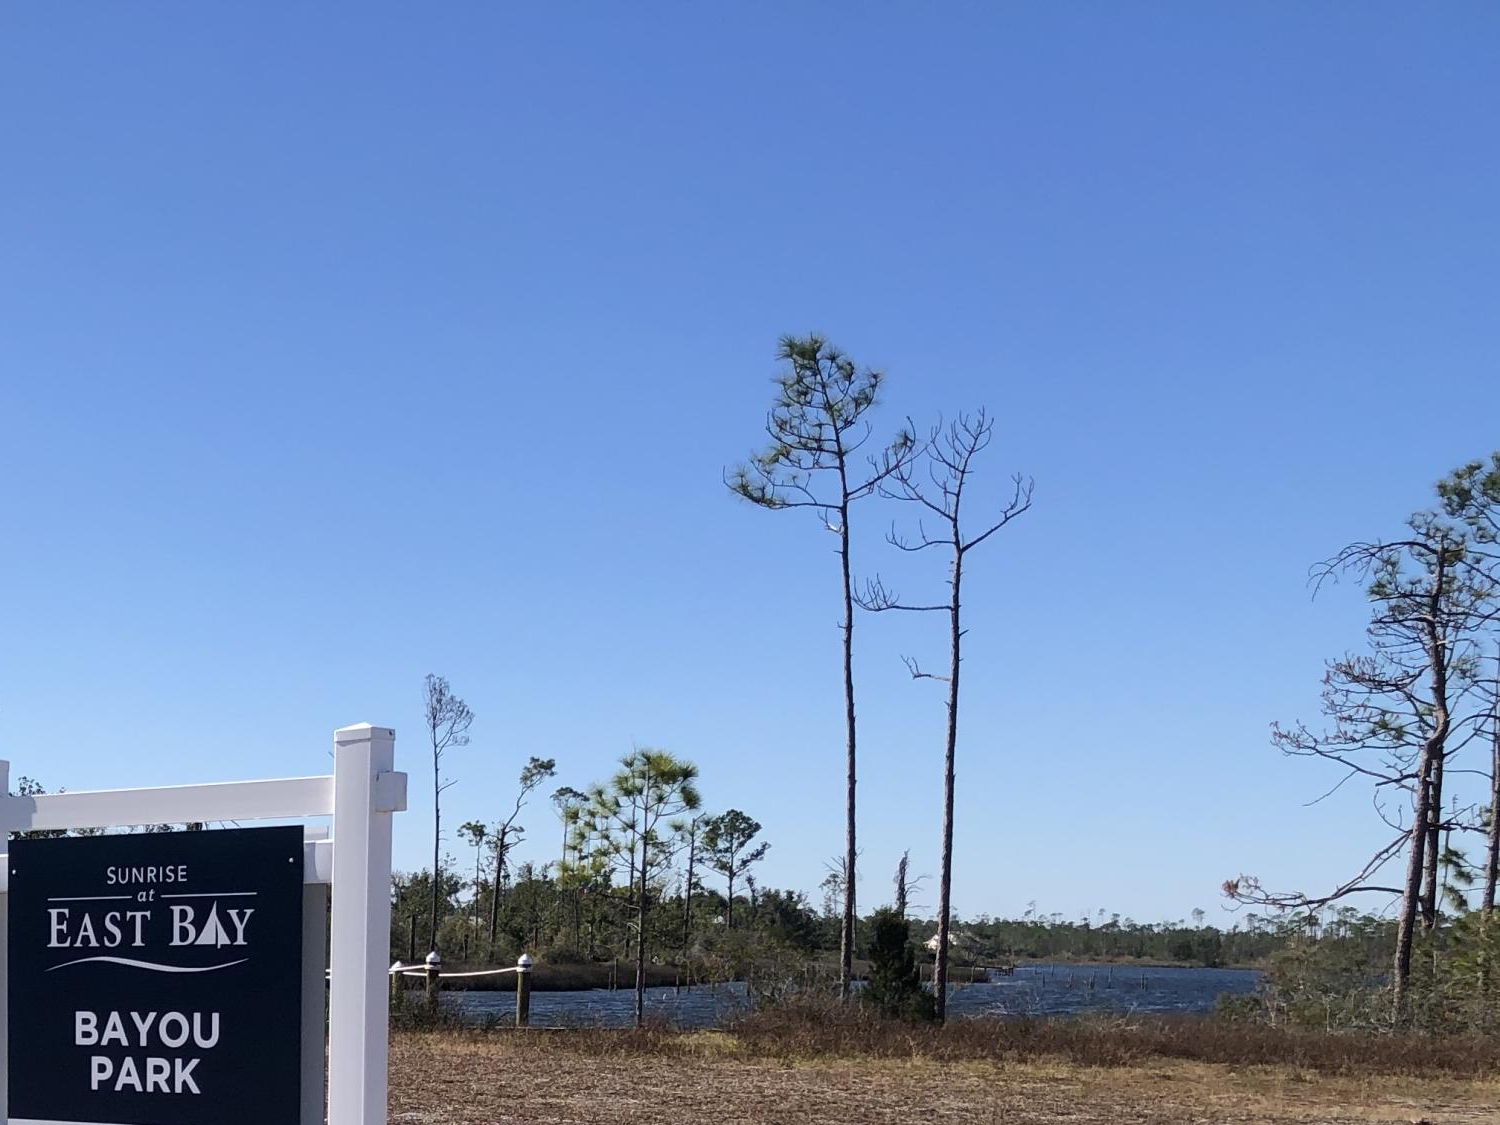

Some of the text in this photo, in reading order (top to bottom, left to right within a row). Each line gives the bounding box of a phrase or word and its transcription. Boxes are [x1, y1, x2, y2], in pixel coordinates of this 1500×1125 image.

[106, 865, 188, 885] SUNRISE
[137, 888, 155, 902] at
[46, 901, 255, 949] EAST BAY
[74, 1010, 221, 1049] BAYOU
[90, 1055, 201, 1094] PARK
